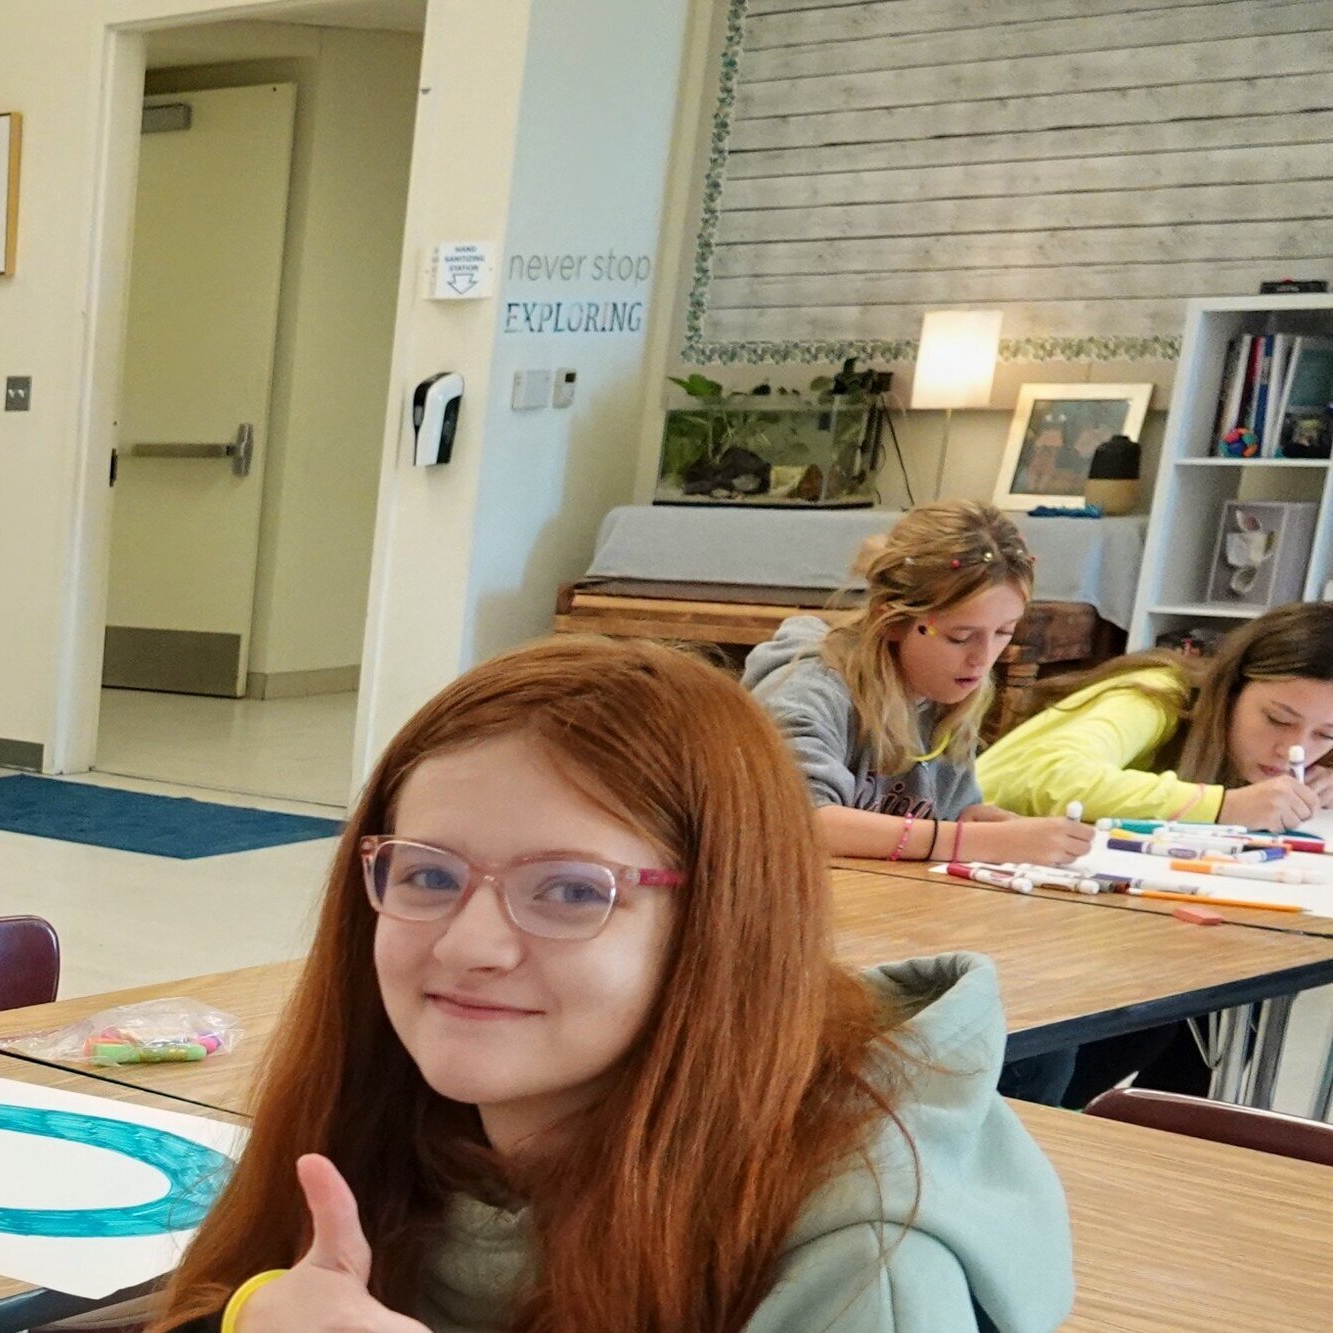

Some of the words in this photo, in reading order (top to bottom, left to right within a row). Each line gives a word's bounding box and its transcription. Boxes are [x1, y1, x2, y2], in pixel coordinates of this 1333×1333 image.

[508, 254, 587, 282] never
[592, 250, 651, 282] stop
[504, 302, 643, 333] EXPLORING
